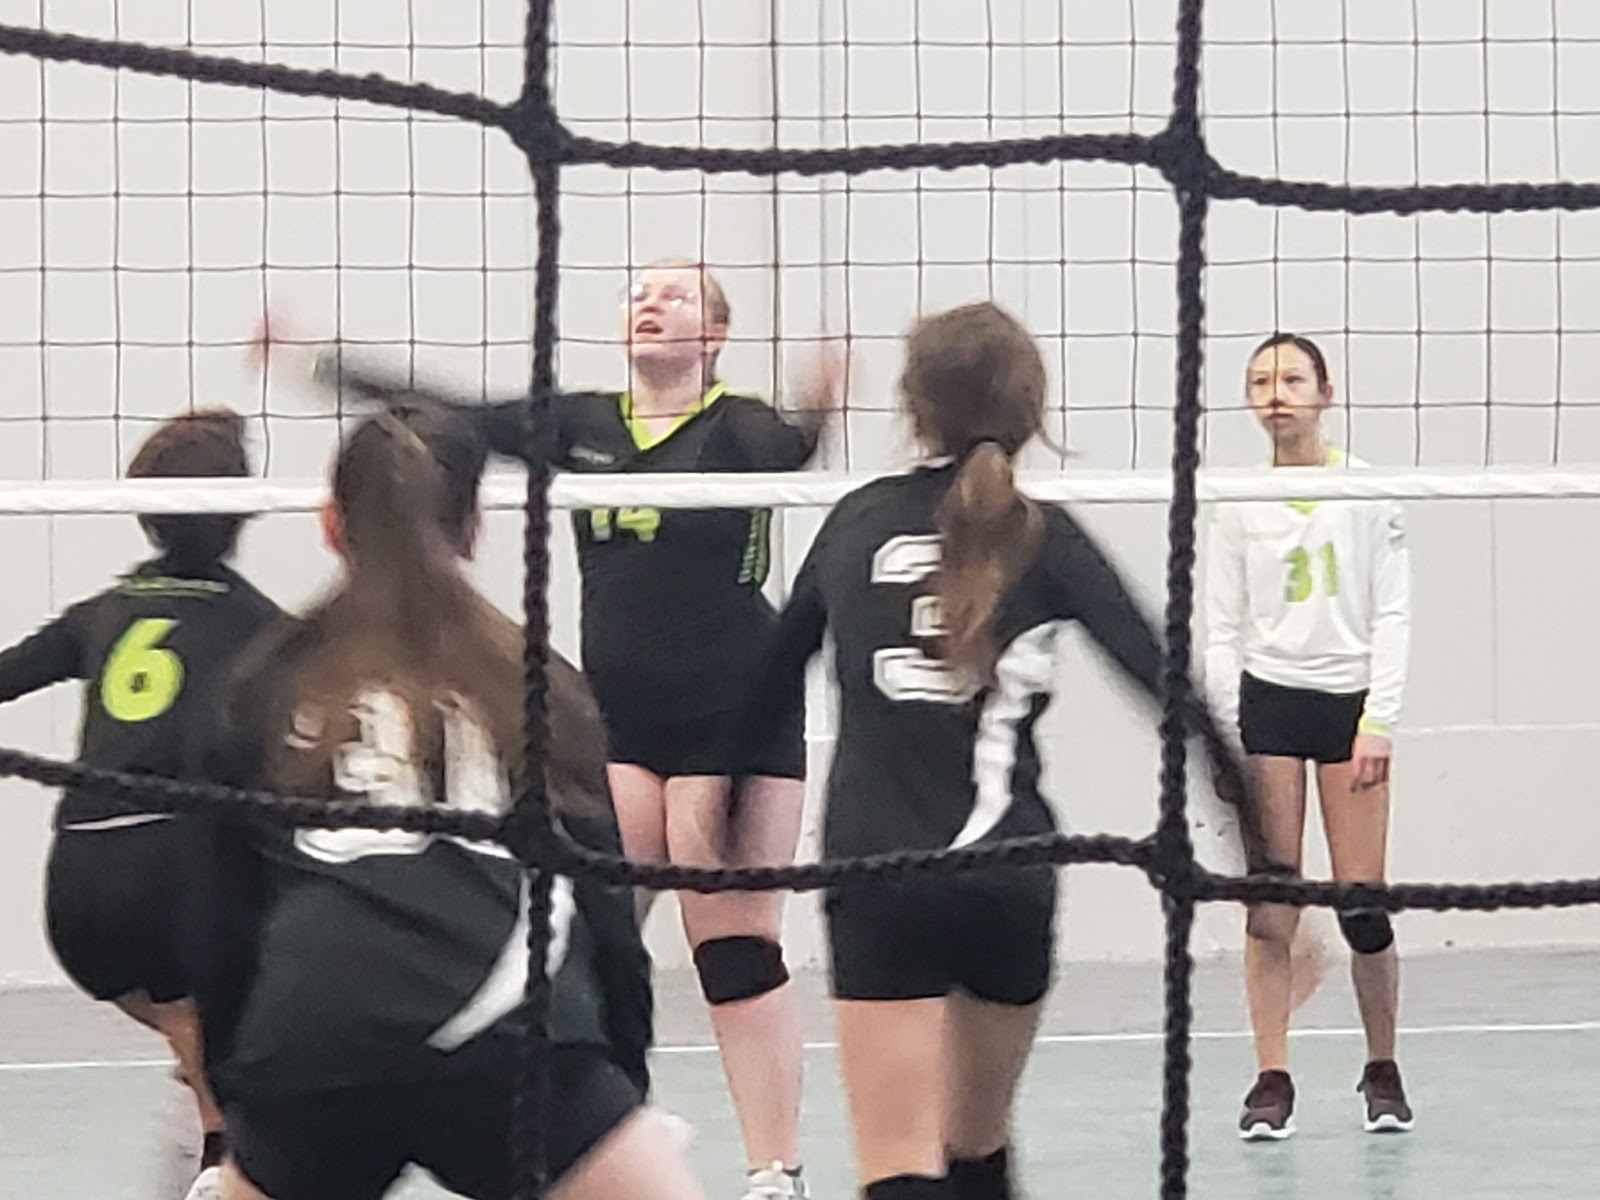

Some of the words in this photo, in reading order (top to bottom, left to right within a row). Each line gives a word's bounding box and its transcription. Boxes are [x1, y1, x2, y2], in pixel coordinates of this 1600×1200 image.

[870, 533, 982, 704] 3
[1283, 541, 1338, 603] 31
[101, 617, 185, 722] 6
